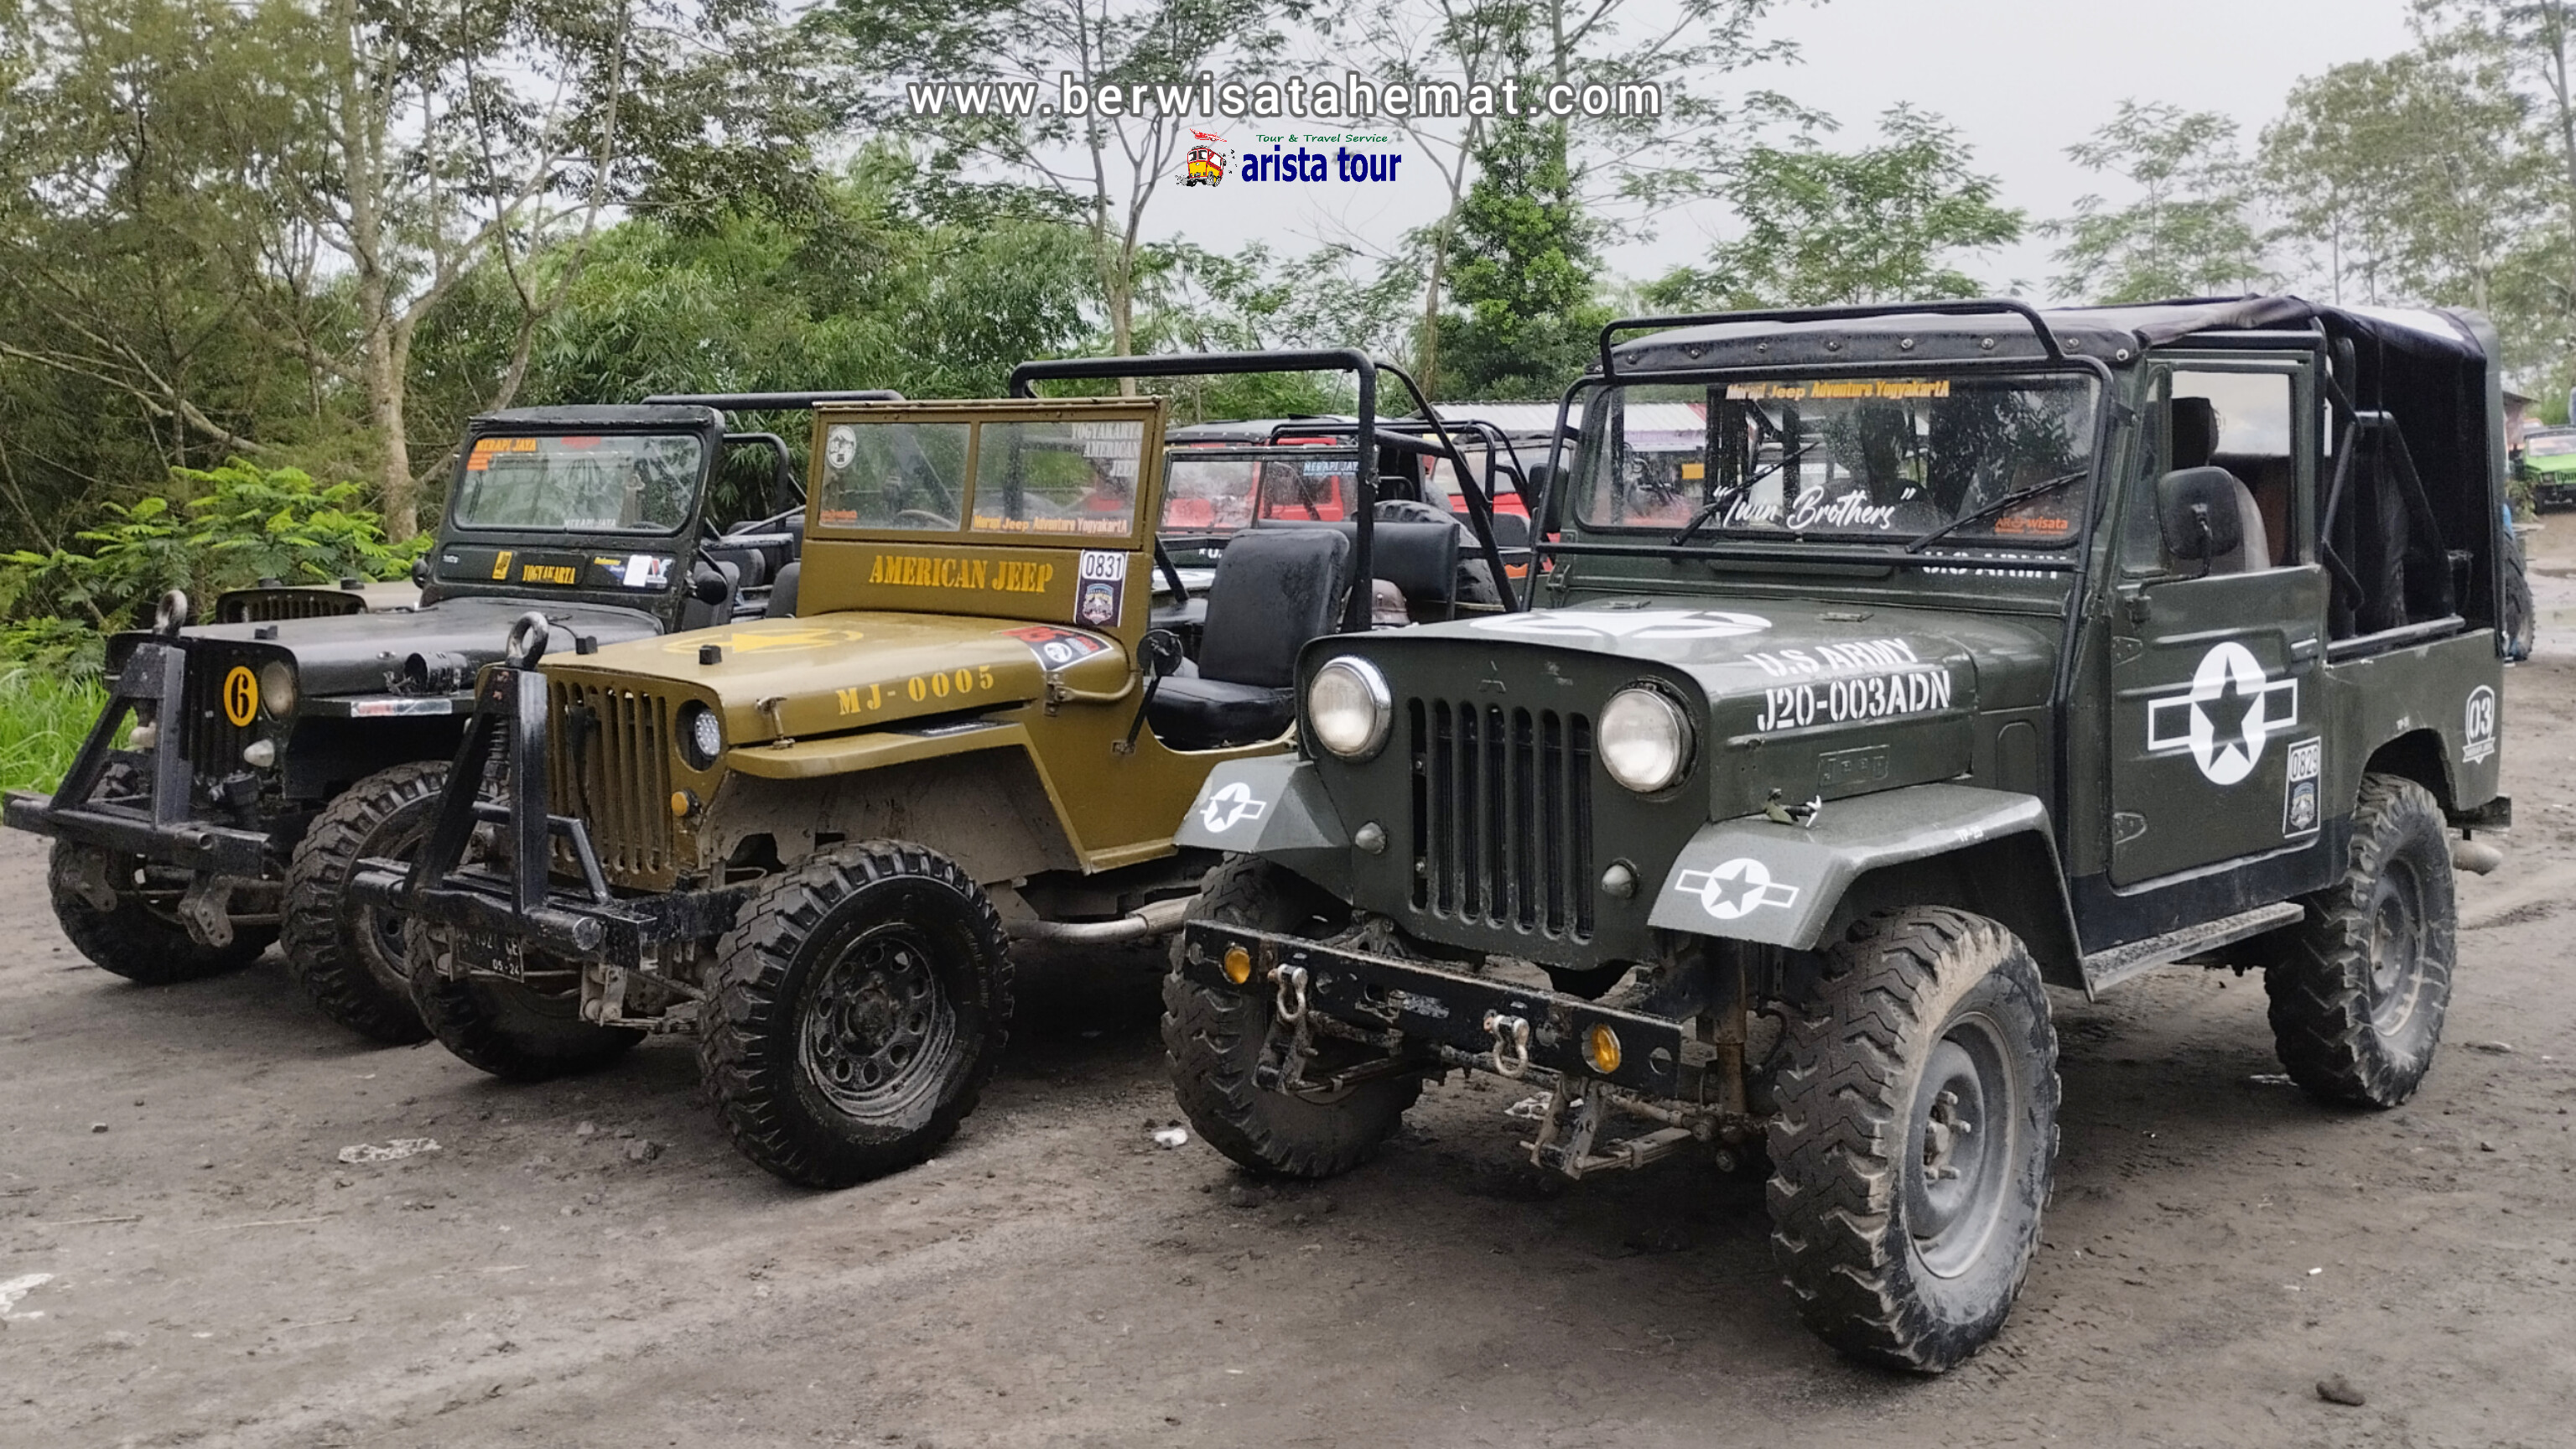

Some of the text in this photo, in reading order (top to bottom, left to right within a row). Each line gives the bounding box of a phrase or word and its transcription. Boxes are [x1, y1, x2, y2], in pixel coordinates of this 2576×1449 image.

[1726, 383, 1766, 400] Merapi
[1768, 385, 1806, 401] Jeep
[1810, 382, 1874, 398] Adventure
[1071, 422, 1143, 439] YOGYAKARTA
[1083, 440, 1141, 457] AMERICAN
[1109, 460, 1139, 477] JEEP
[1304, 461, 1358, 471] MERAPI JAY
[973, 515, 1001, 530] Merapi
[1002, 517, 1029, 532] Jeep
[1032, 517, 1076, 531] Adventure
[2025, 516, 2069, 529] wisata
[522, 564, 576, 584] YOGYAKARTA
[869, 554, 1054, 593] AMERICAN JEEP
[1085, 554, 1122, 579] 0831
[1743, 637, 1919, 677] U.S ARMY
[231, 673, 250, 719] 6
[1757, 670, 1950, 732] J20-003ADN
[2469, 697, 2492, 739] 03
[2292, 747, 2318, 779] 0829
